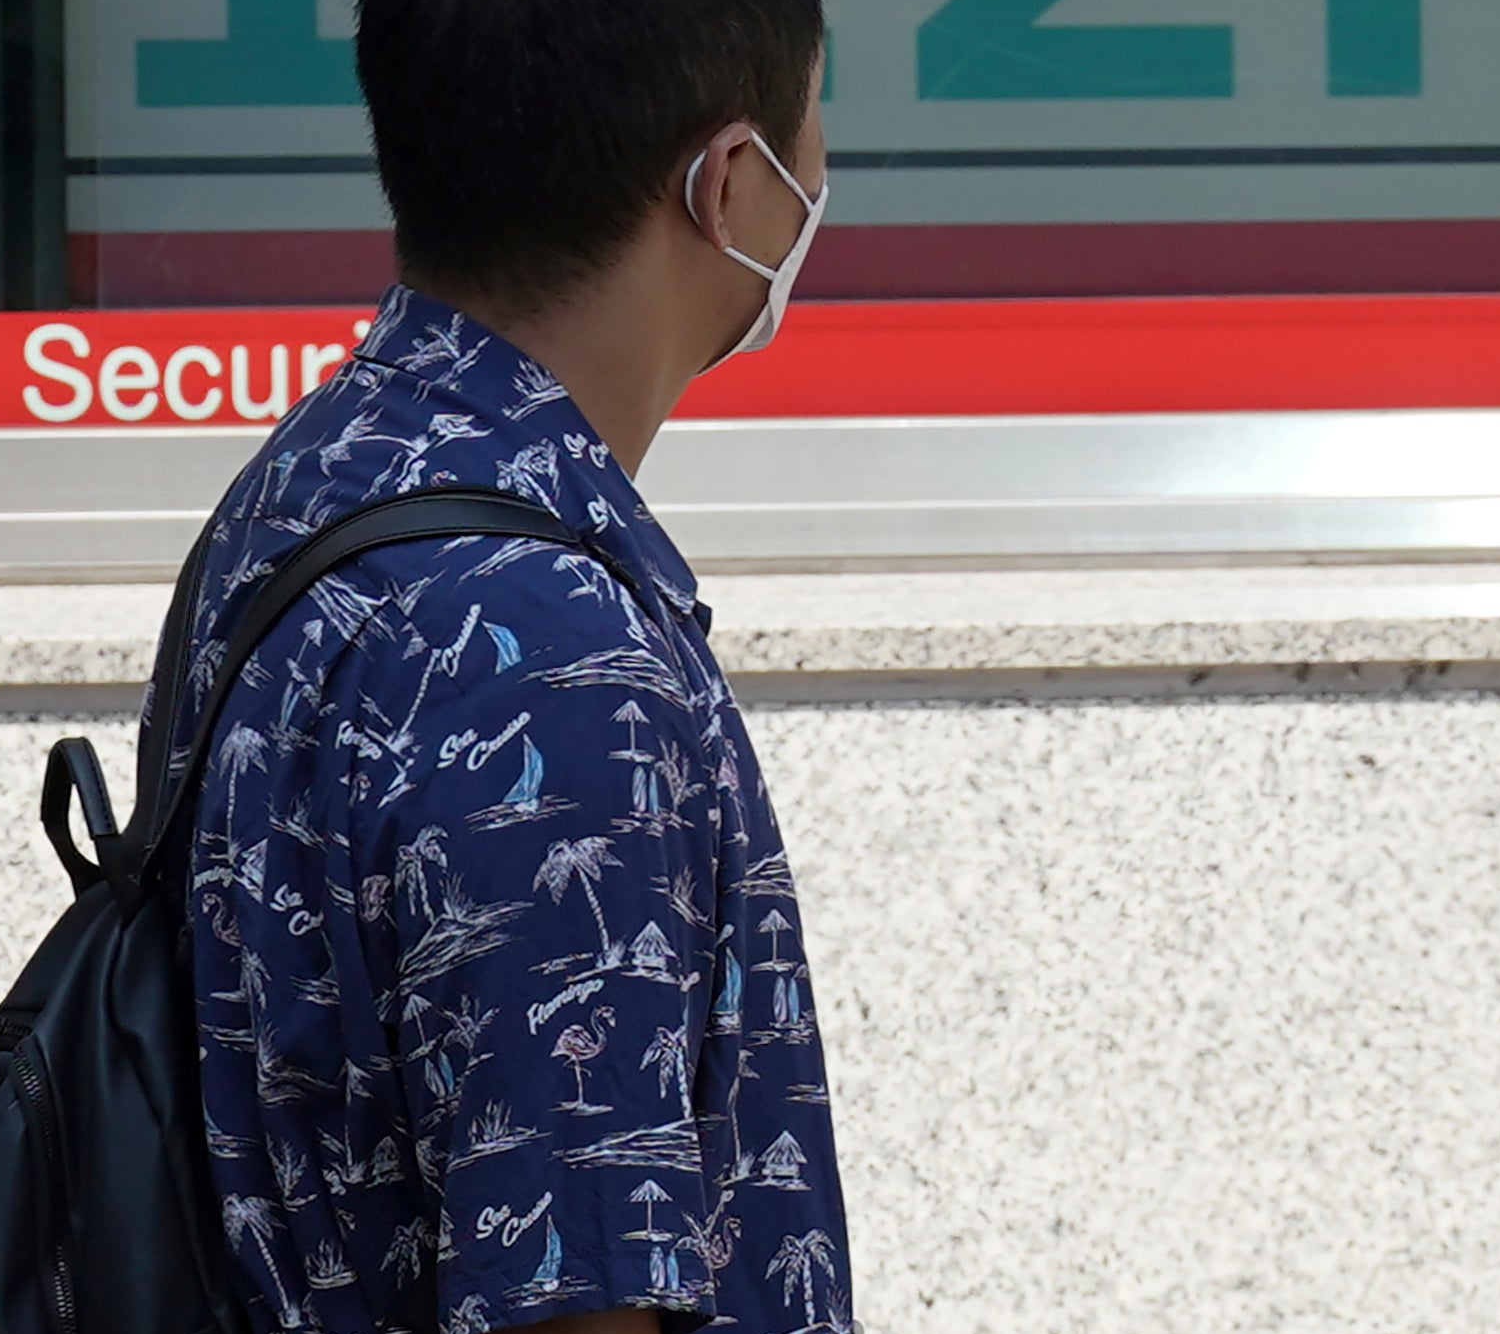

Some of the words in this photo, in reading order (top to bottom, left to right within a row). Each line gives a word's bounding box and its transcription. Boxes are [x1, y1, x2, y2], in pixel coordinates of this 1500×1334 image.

[23, 318, 373, 423] Secur
[437, 728, 479, 768] Sea
[466, 711, 532, 771] Cruise
[526, 979, 605, 1036] Flamingo
[476, 1205, 512, 1240] Sea
